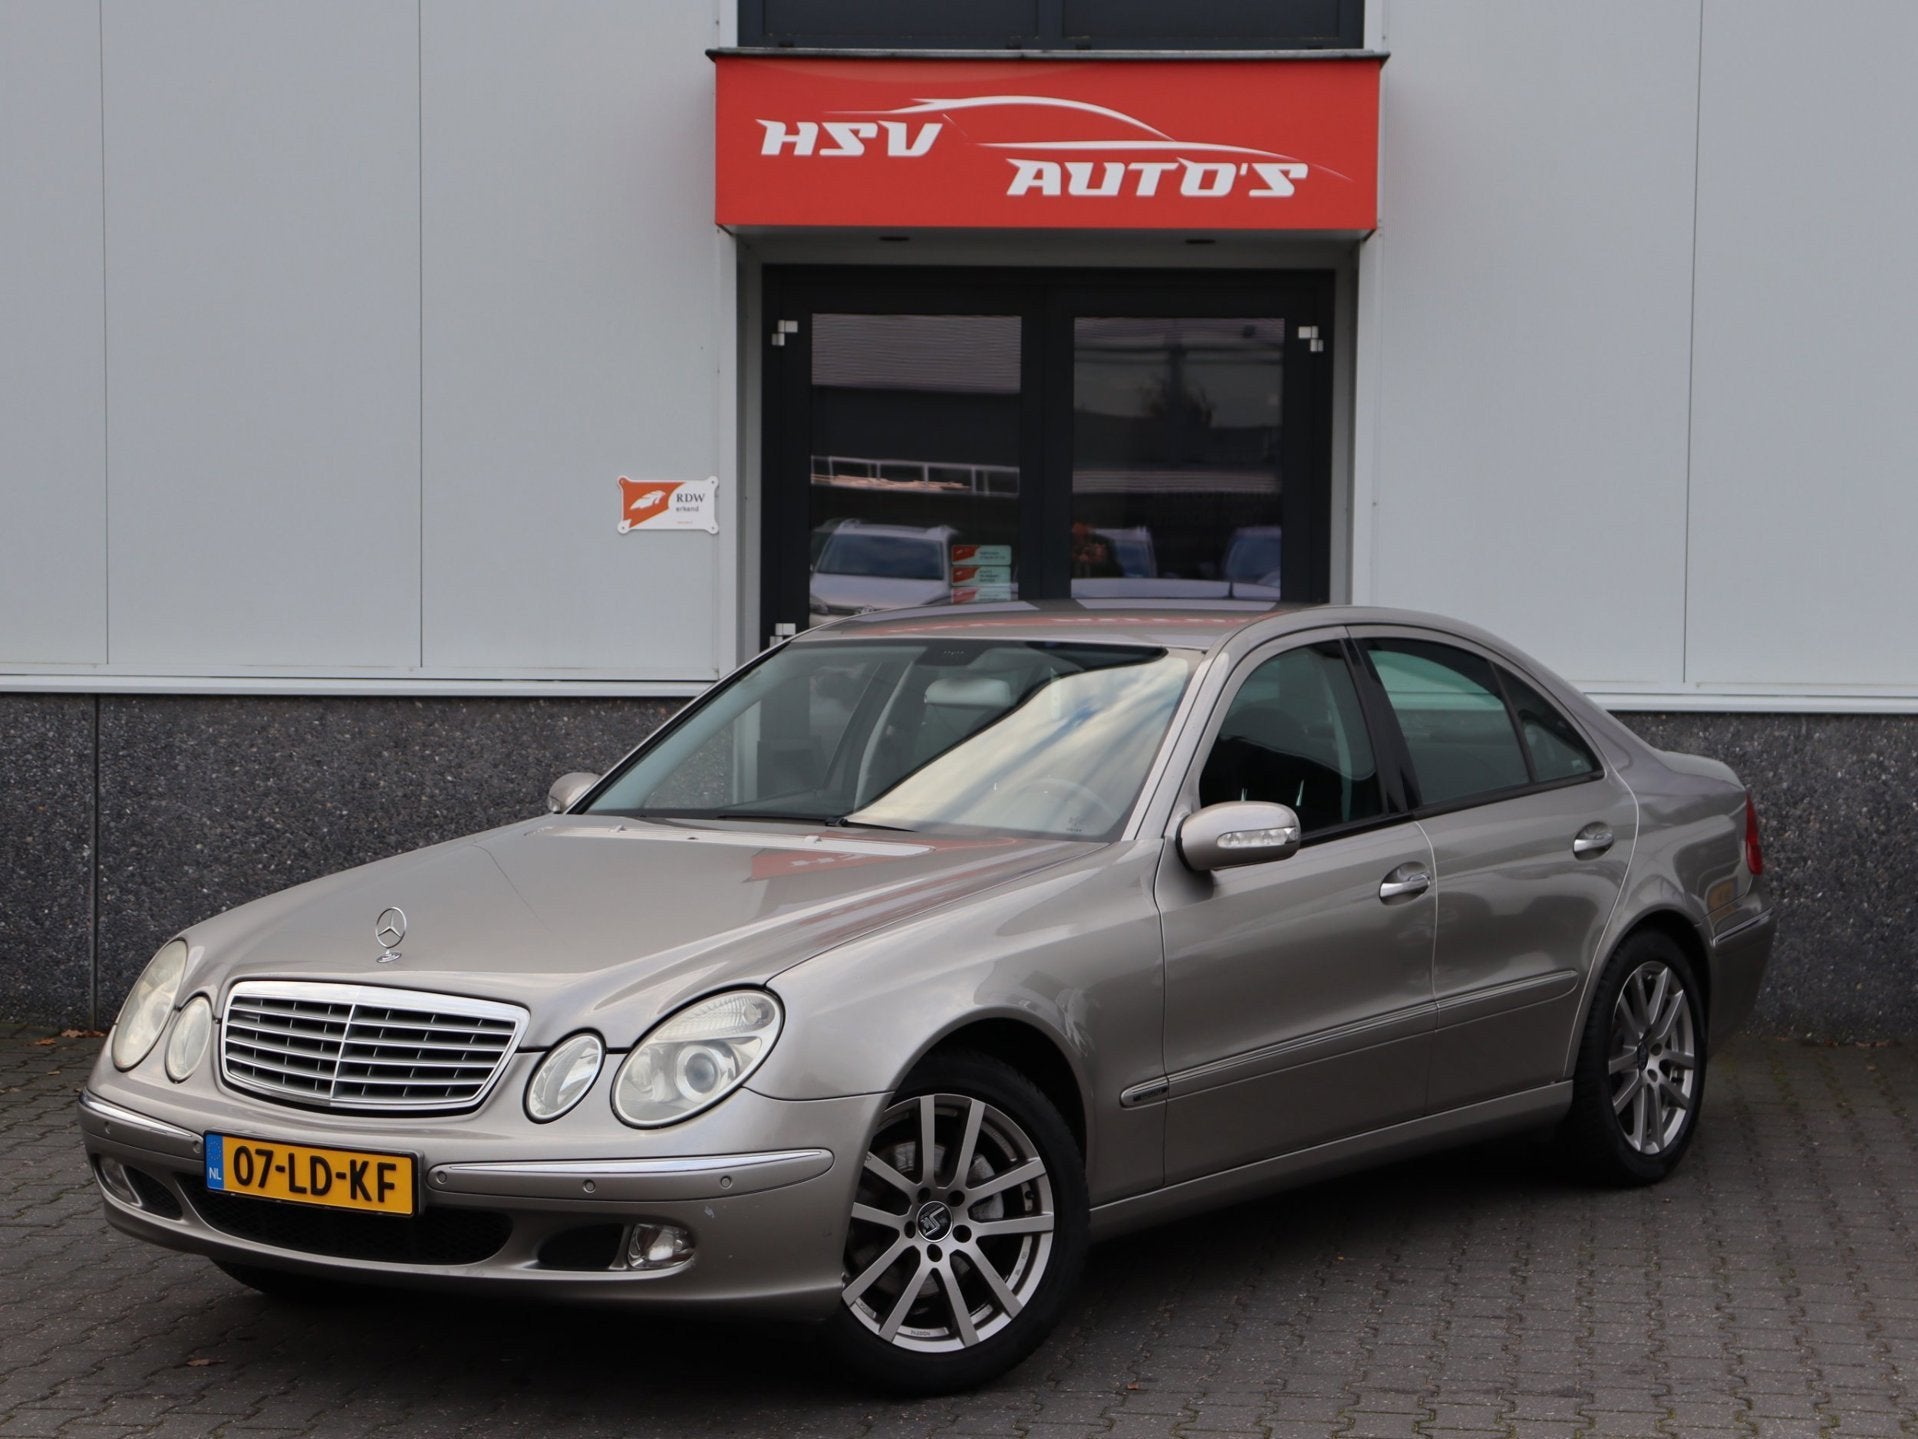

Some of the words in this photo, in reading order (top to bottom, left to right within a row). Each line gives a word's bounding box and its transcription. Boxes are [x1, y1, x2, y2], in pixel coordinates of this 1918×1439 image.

[757, 119, 943, 157] HSV
[1007, 157, 1309, 198] AUTO'S
[676, 493, 705, 503] RDW
[209, 1167, 222, 1180] NL
[233, 1145, 397, 1203] 07-LD-KF
